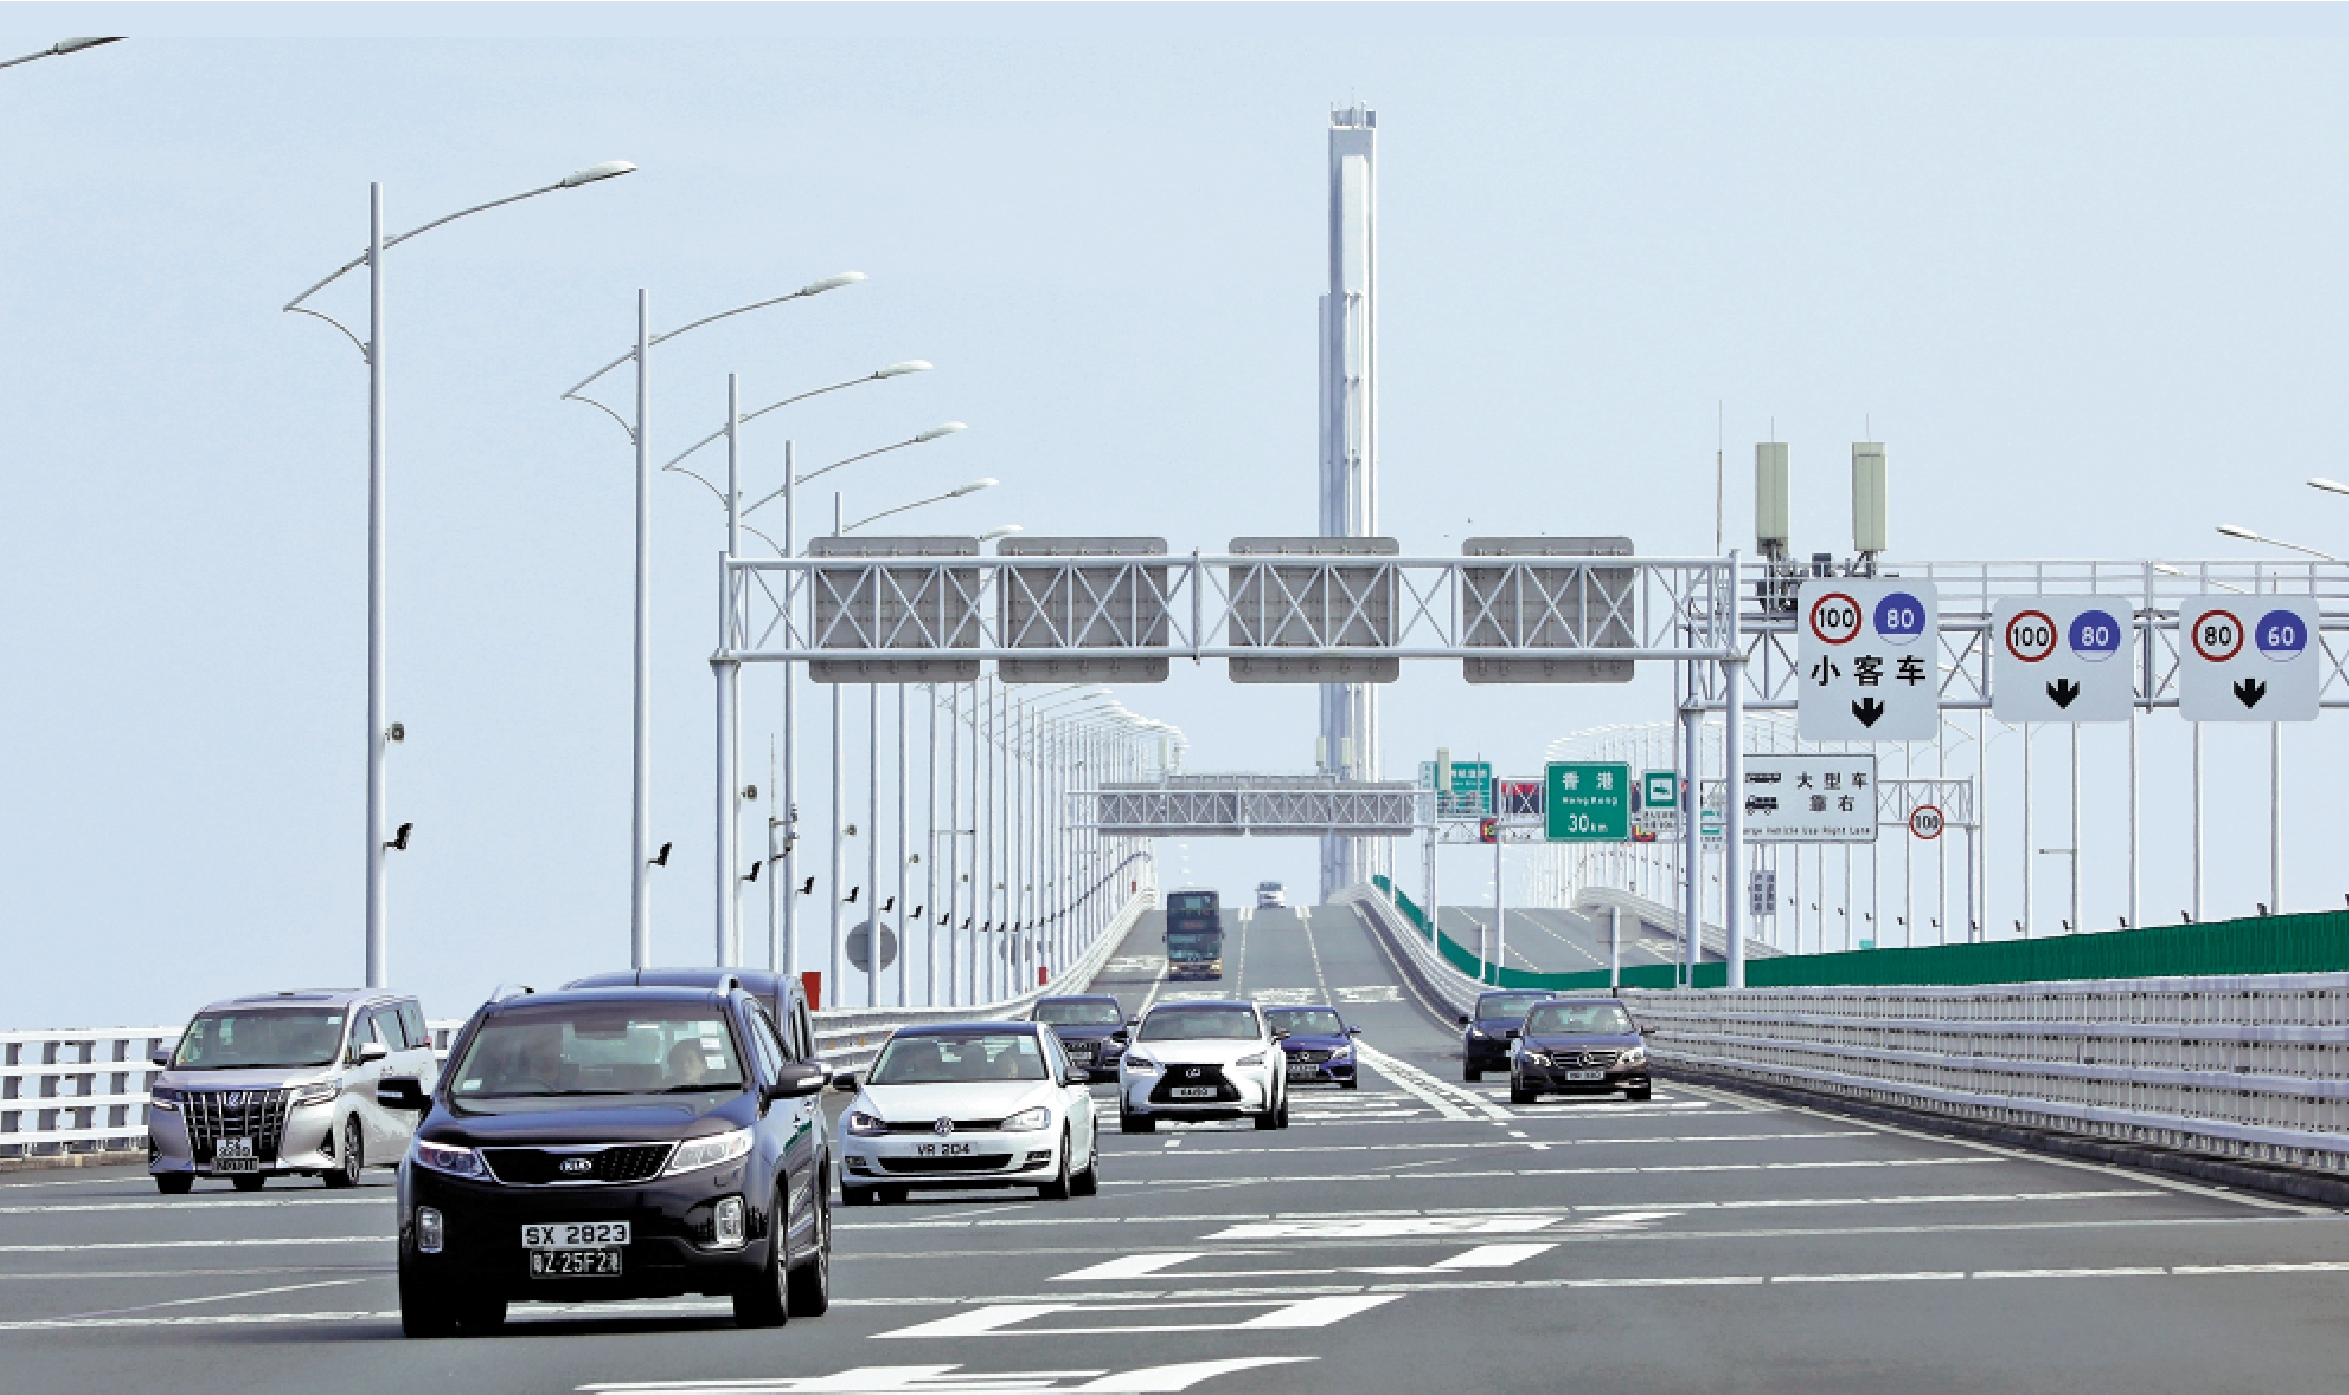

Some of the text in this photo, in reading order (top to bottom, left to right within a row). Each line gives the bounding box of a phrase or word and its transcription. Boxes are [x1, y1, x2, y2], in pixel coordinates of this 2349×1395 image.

[1819, 608, 1854, 627] 100
[1888, 608, 1914, 629] 80
[2012, 627, 2048, 646] 100
[2081, 627, 2109, 646] 80
[2204, 626, 2231, 646] 80
[2268, 627, 2295, 646] 60
[1810, 655, 1926, 686] 小客车
[1561, 771, 1613, 790] 香港
[1796, 771, 1869, 790] 大型车
[1916, 816, 1940, 829] 100
[526, 1225, 627, 1244] SX 2823
